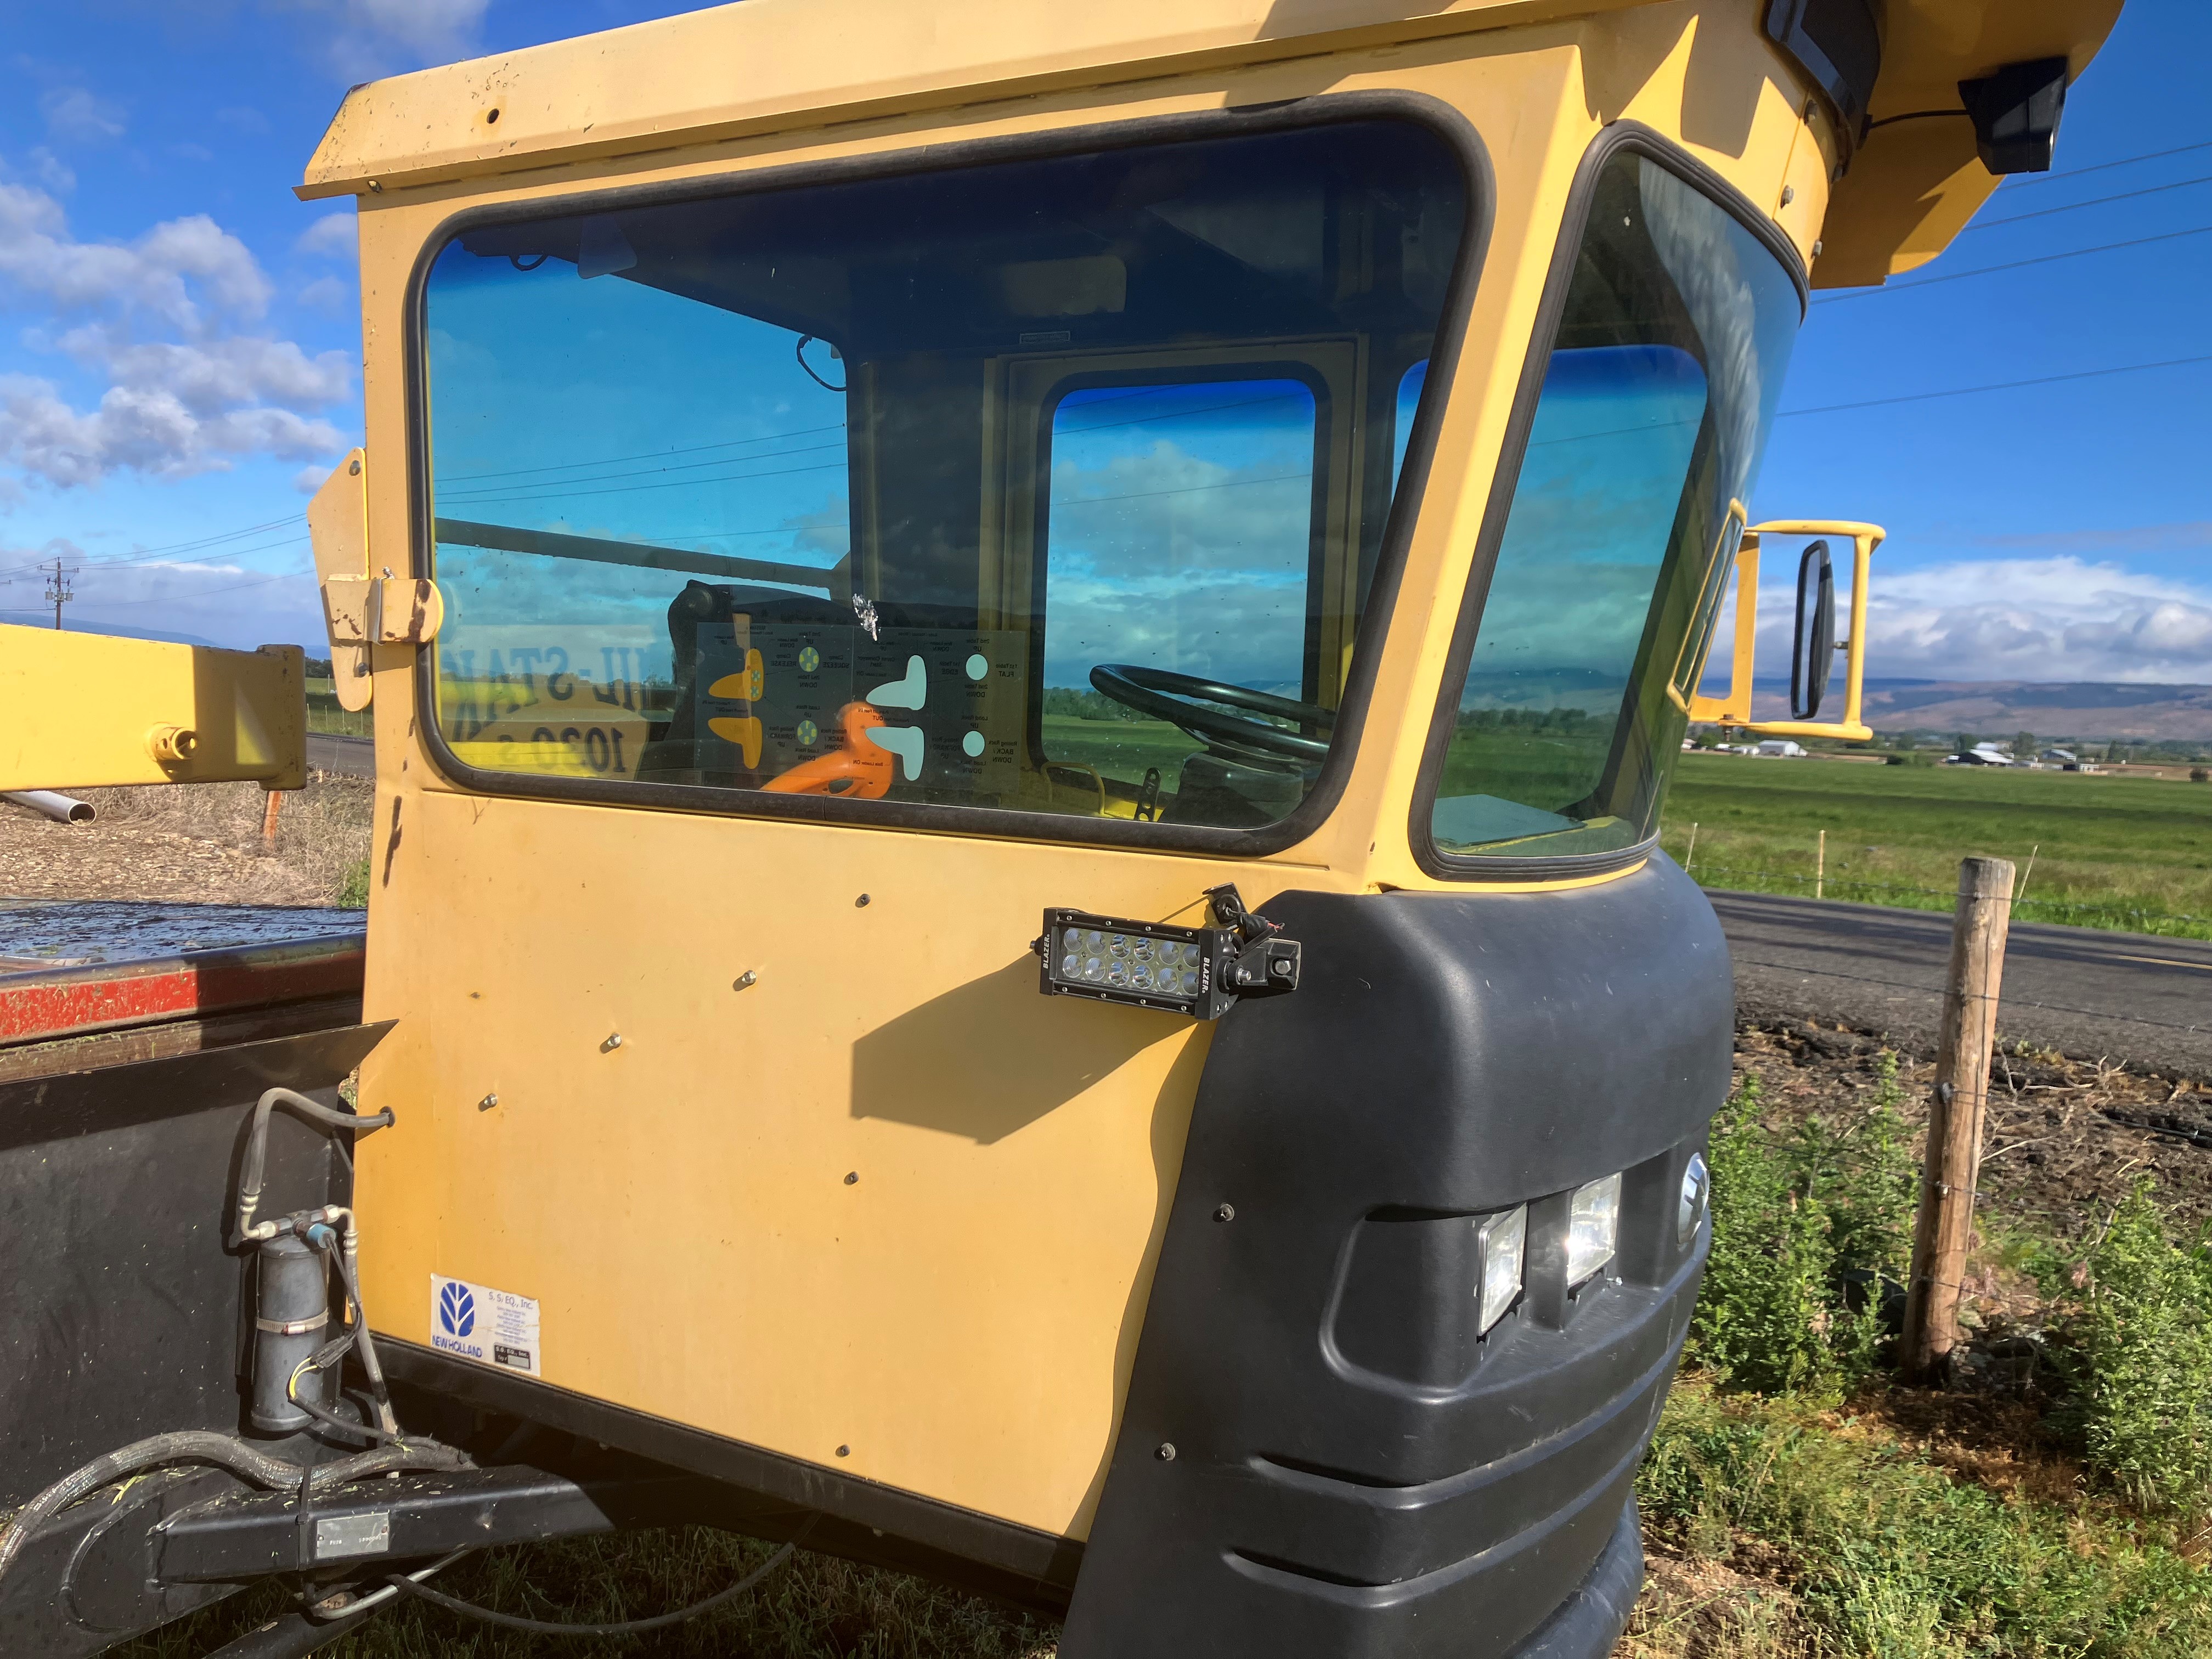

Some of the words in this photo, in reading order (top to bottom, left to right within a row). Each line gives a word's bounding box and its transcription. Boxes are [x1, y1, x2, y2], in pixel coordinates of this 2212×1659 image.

[521, 1299, 533, 1310] Inc.
[432, 1335, 448, 1348] NEW
[448, 1339, 483, 1358] HOLLAND
